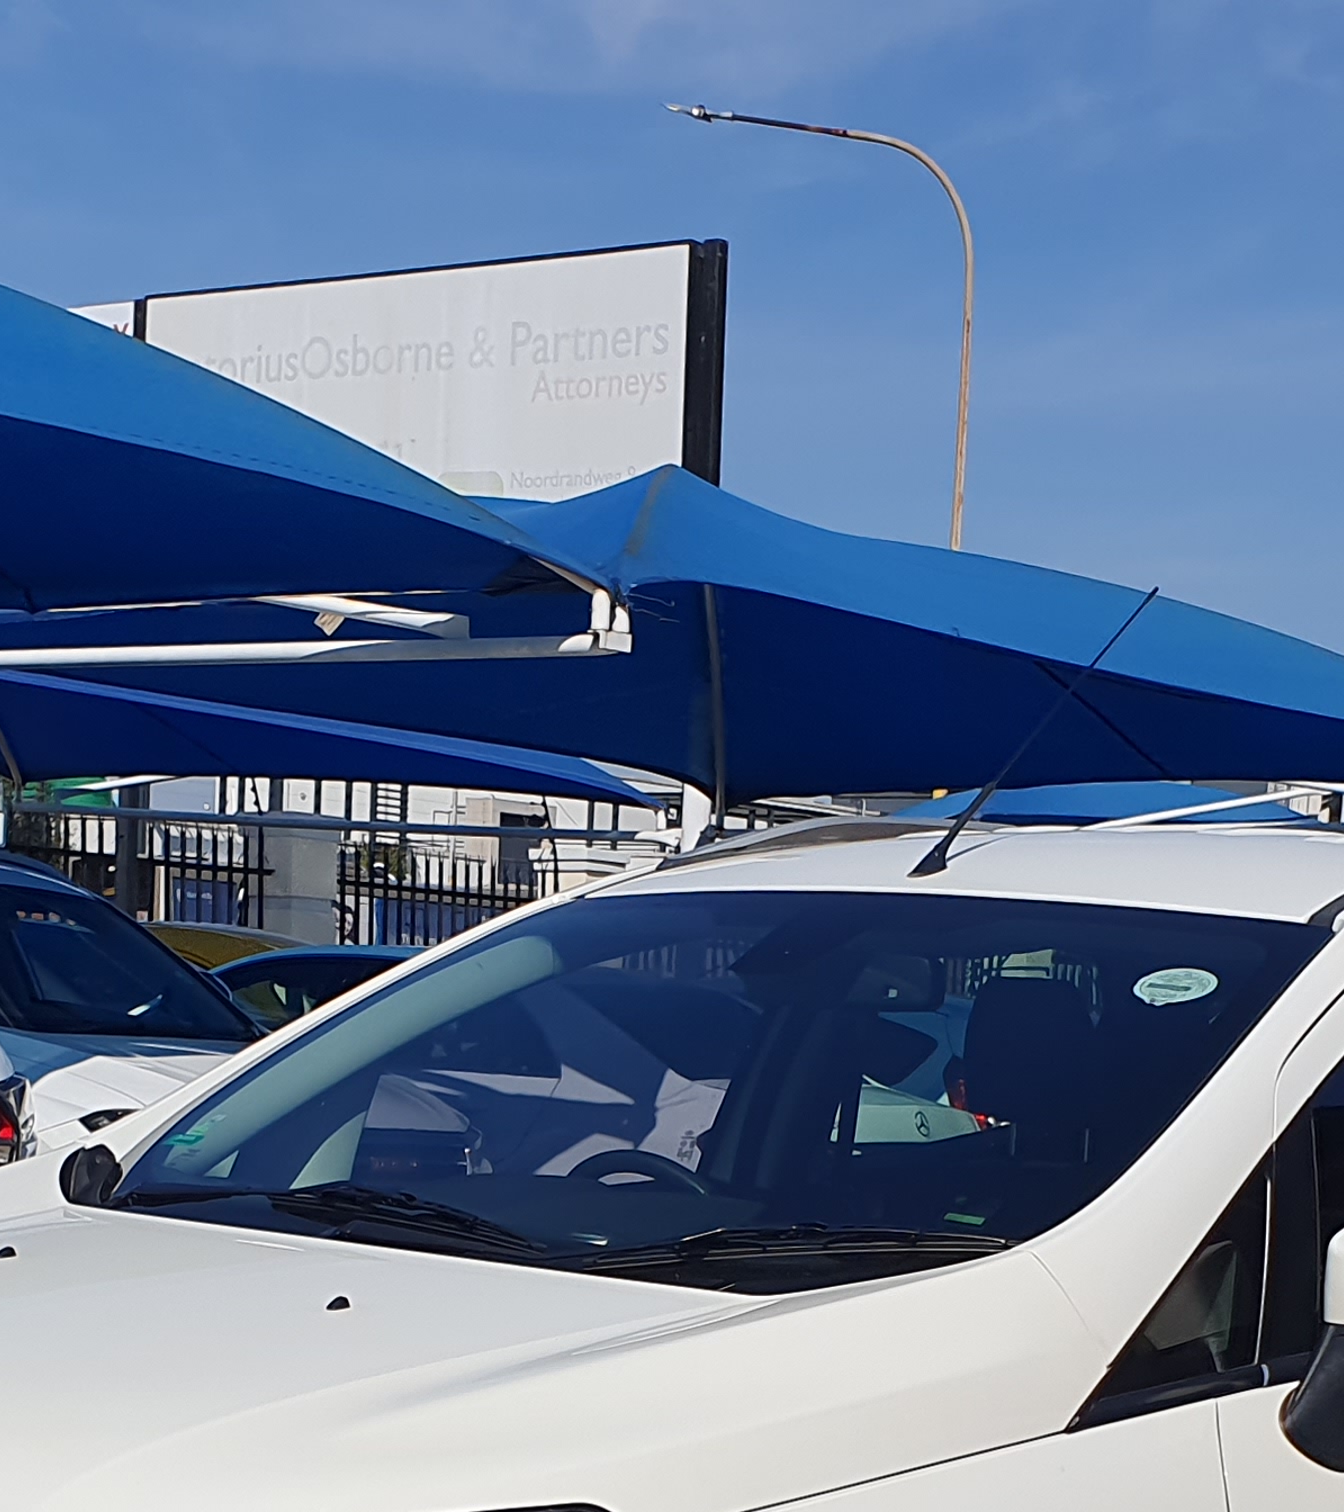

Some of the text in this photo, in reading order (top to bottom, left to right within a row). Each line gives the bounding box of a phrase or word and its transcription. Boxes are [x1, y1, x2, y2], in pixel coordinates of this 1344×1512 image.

[468, 326, 495, 369] &
[510, 321, 669, 366] Partners
[531, 370, 667, 406] Attorneys
